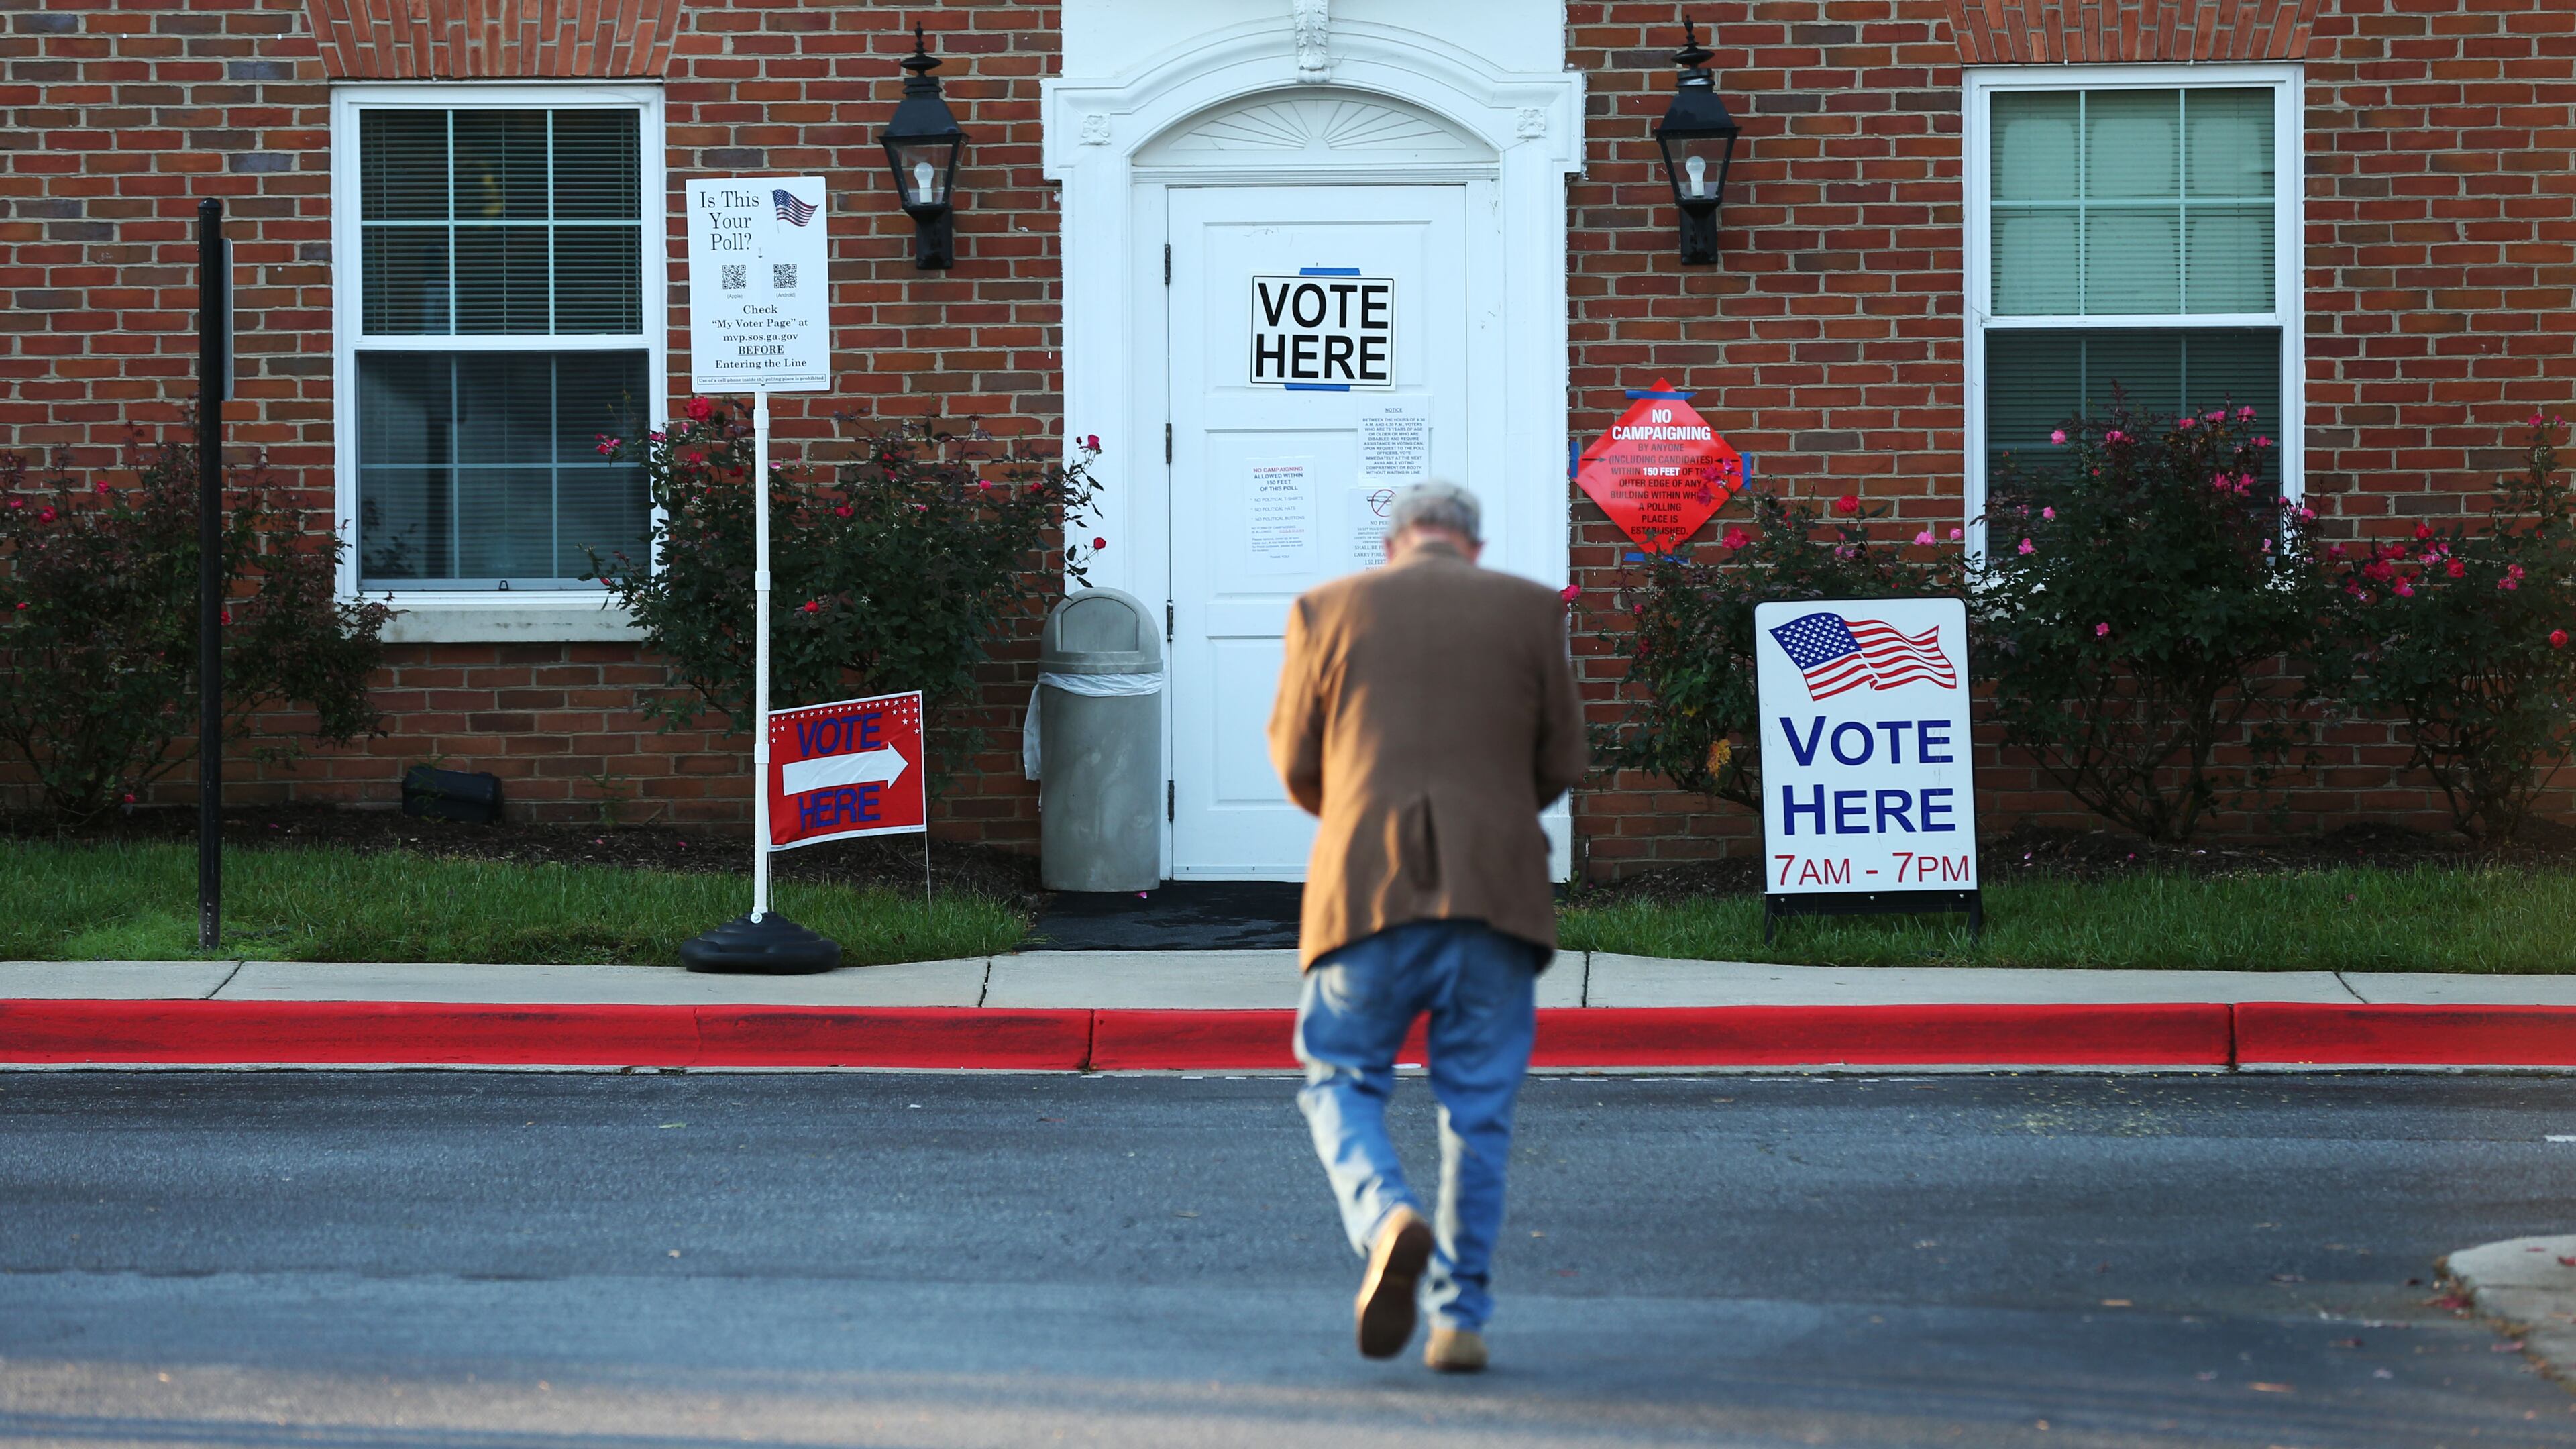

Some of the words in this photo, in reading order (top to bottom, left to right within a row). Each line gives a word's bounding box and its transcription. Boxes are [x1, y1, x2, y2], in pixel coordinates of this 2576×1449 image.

[700, 191, 715, 208] Is
[721, 191, 759, 207] This
[708, 212, 751, 229] Your
[710, 233, 751, 250] Poll?
[743, 305, 777, 314] Check
[1258, 282, 1389, 329] VOTE
[735, 319, 763, 327] Voter
[724, 333, 798, 343] mvp.sos.ga.gov
[739, 345, 784, 355] BEFORE
[1256, 333, 1387, 380] HERE
[716, 360, 761, 369] Entering
[765, 359, 781, 367] the
[784, 359, 806, 367] Line
[1652, 409, 1672, 423] NO
[1612, 426, 1711, 440] CAMPAIGNING
[1609, 455, 1656, 464] (INCLUDING
[1658, 456, 1713, 464] CANDIDATES)
[1643, 467, 1658, 476] 150
[1660, 467, 1680, 476] FEET
[1611, 491, 1649, 499] BUILDING
[796, 712, 881, 757] VOTE
[1779, 716, 1953, 766] VOTE
[798, 786, 881, 832] HERE
[1782, 784, 1956, 835] HERE
[1774, 855, 1851, 885] 7AM
[1892, 852, 1969, 883] 7PM
